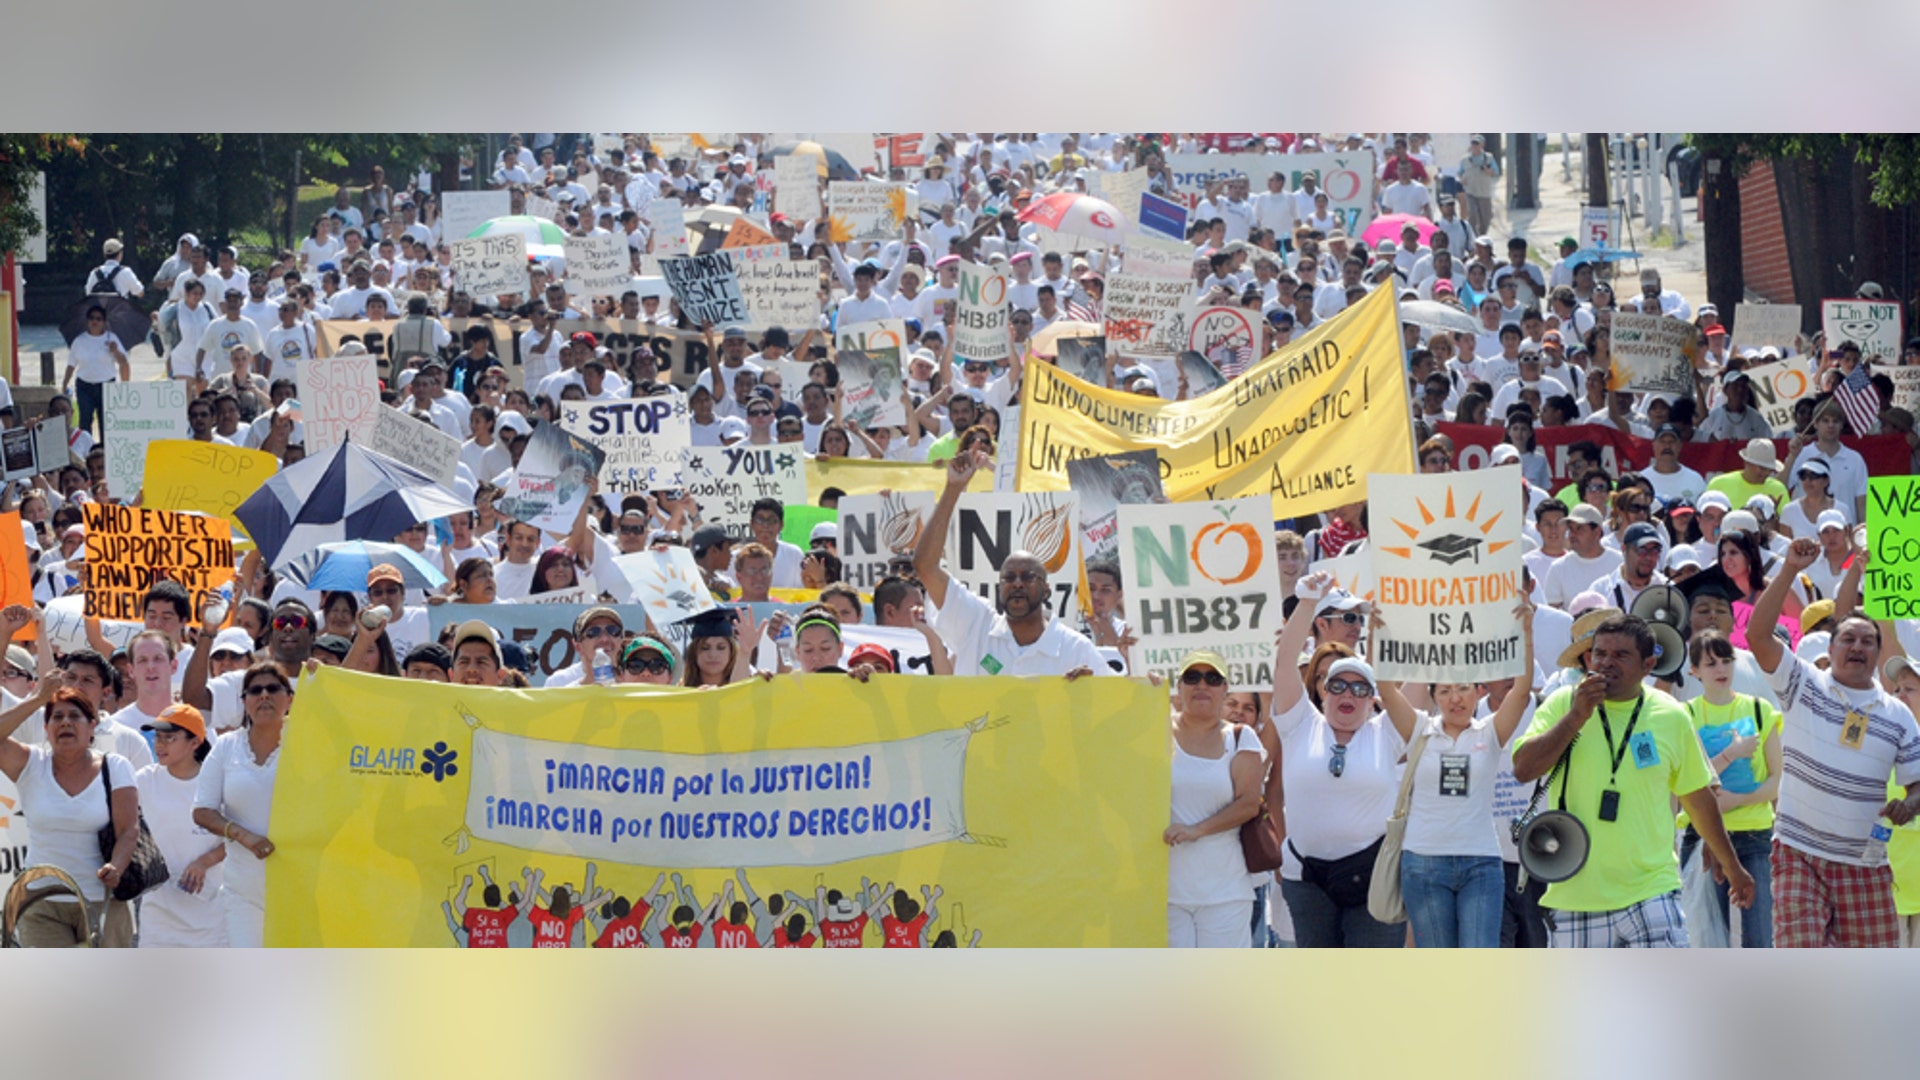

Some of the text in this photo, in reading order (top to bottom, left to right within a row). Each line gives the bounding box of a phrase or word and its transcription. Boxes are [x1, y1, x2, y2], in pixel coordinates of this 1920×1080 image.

[960, 271, 1006, 307] NO
[1109, 278, 1150, 291] GEORGIA
[1138, 296, 1181, 309] WITHOUT
[1832, 303, 1897, 320] I'm NOT
[958, 306, 1006, 329] HB87
[1204, 315, 1236, 333] NO
[307, 359, 370, 391] SAY
[1033, 363, 1198, 438] UNDOCUMENTED
[588, 401, 672, 436] STOP
[181, 446, 255, 478] STOP
[722, 447, 774, 476] YOU
[606, 478, 650, 495] THIS
[753, 477, 783, 497] the
[1271, 462, 1356, 499] ALLIANCE
[84, 504, 131, 534] WHO
[1132, 521, 1263, 587] NO
[85, 563, 131, 589] LAW
[1379, 571, 1517, 606] EDUCATION
[84, 589, 147, 620] BELIEV
[1140, 592, 1267, 635] HB87
[1430, 611, 1474, 635] IS A
[1379, 636, 1519, 666] HUMAN RIGHT
[350, 745, 416, 770] GLAHR
[672, 773, 714, 802] por
[721, 768, 744, 794] la
[749, 755, 871, 794] JUSTICIA!
[611, 815, 652, 843] por
[660, 810, 781, 839] NUESTROS
[788, 796, 932, 836] DERECHOS!
[541, 920, 567, 939] NO
[612, 925, 637, 948] NO
[671, 936, 692, 948] NO
[721, 930, 747, 948] NO
